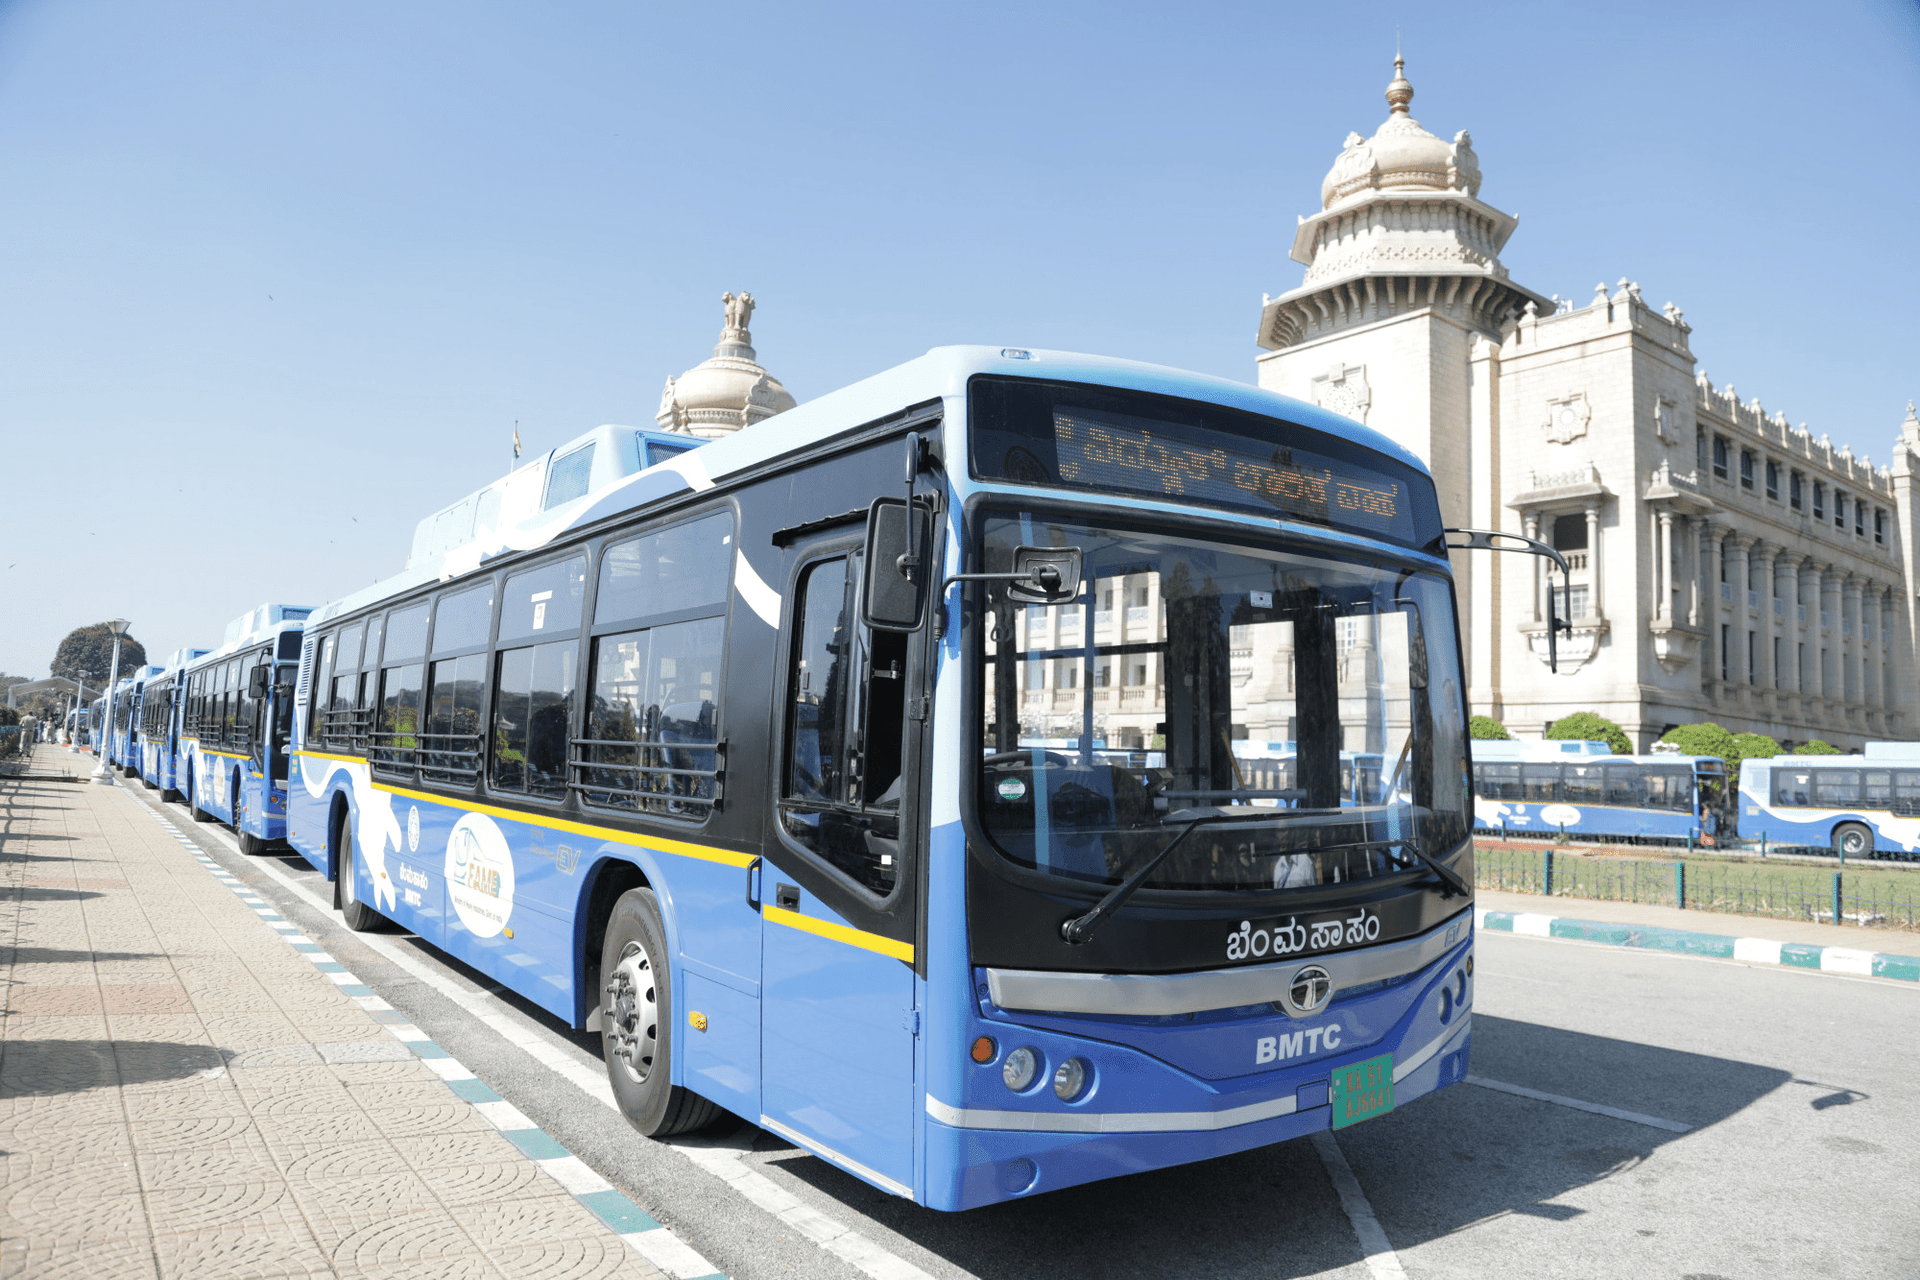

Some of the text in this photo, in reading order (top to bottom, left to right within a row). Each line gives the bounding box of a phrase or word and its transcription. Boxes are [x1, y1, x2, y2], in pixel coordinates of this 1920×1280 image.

[1255, 1023, 1342, 1065] BMTC
[1346, 1063, 1382, 1094] KA 51
